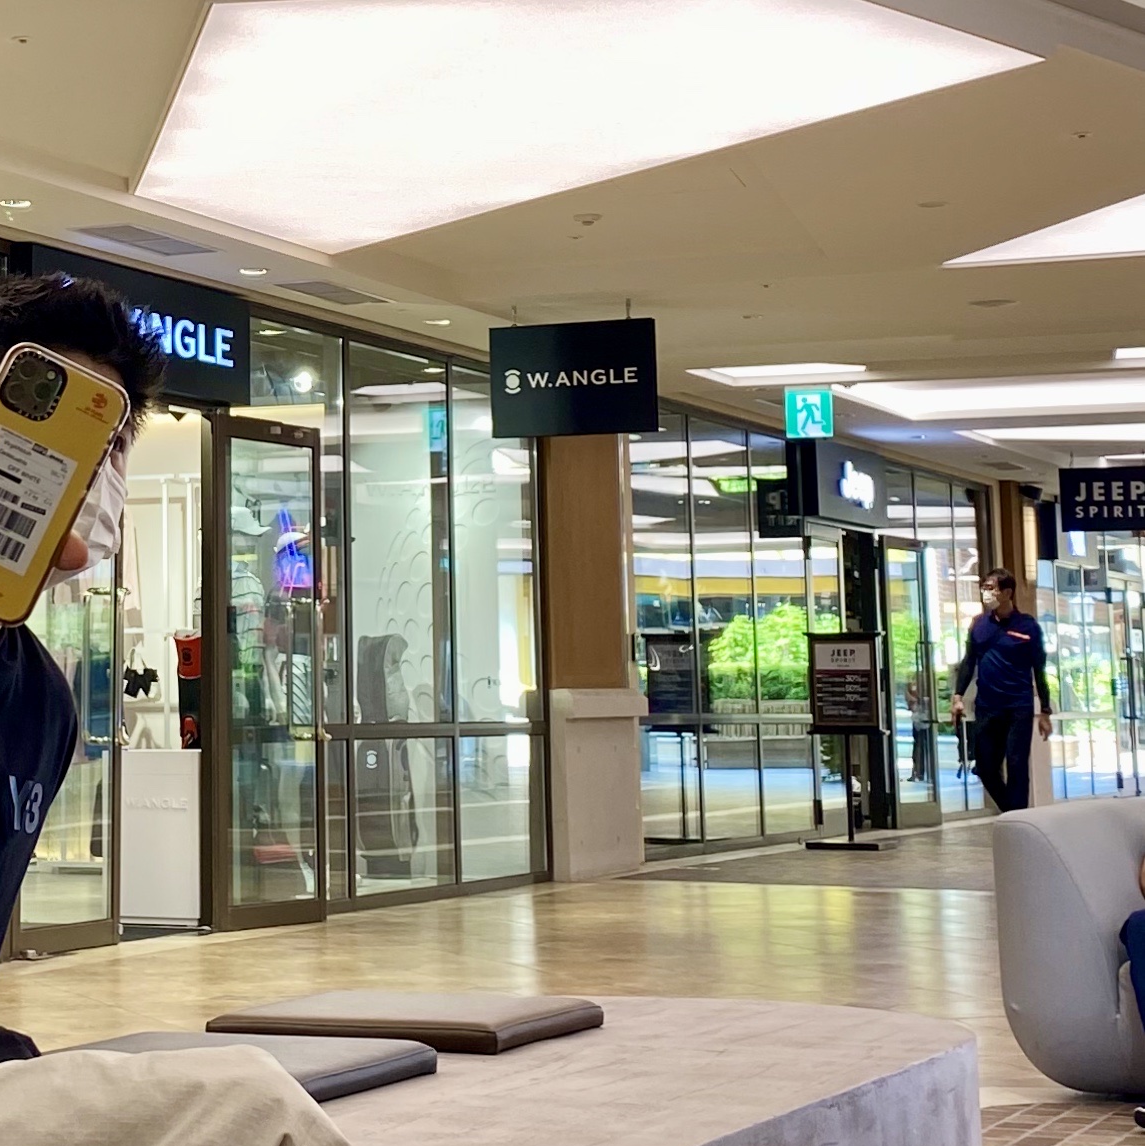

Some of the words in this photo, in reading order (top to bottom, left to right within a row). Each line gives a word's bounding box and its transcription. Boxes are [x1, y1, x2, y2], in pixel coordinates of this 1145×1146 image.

[527, 366, 639, 388] W.ANGLE
[1075, 481, 1145, 502] JEEP
[1075, 505, 1145, 519] SPIRIT
[830, 649, 856, 657] JEEP
